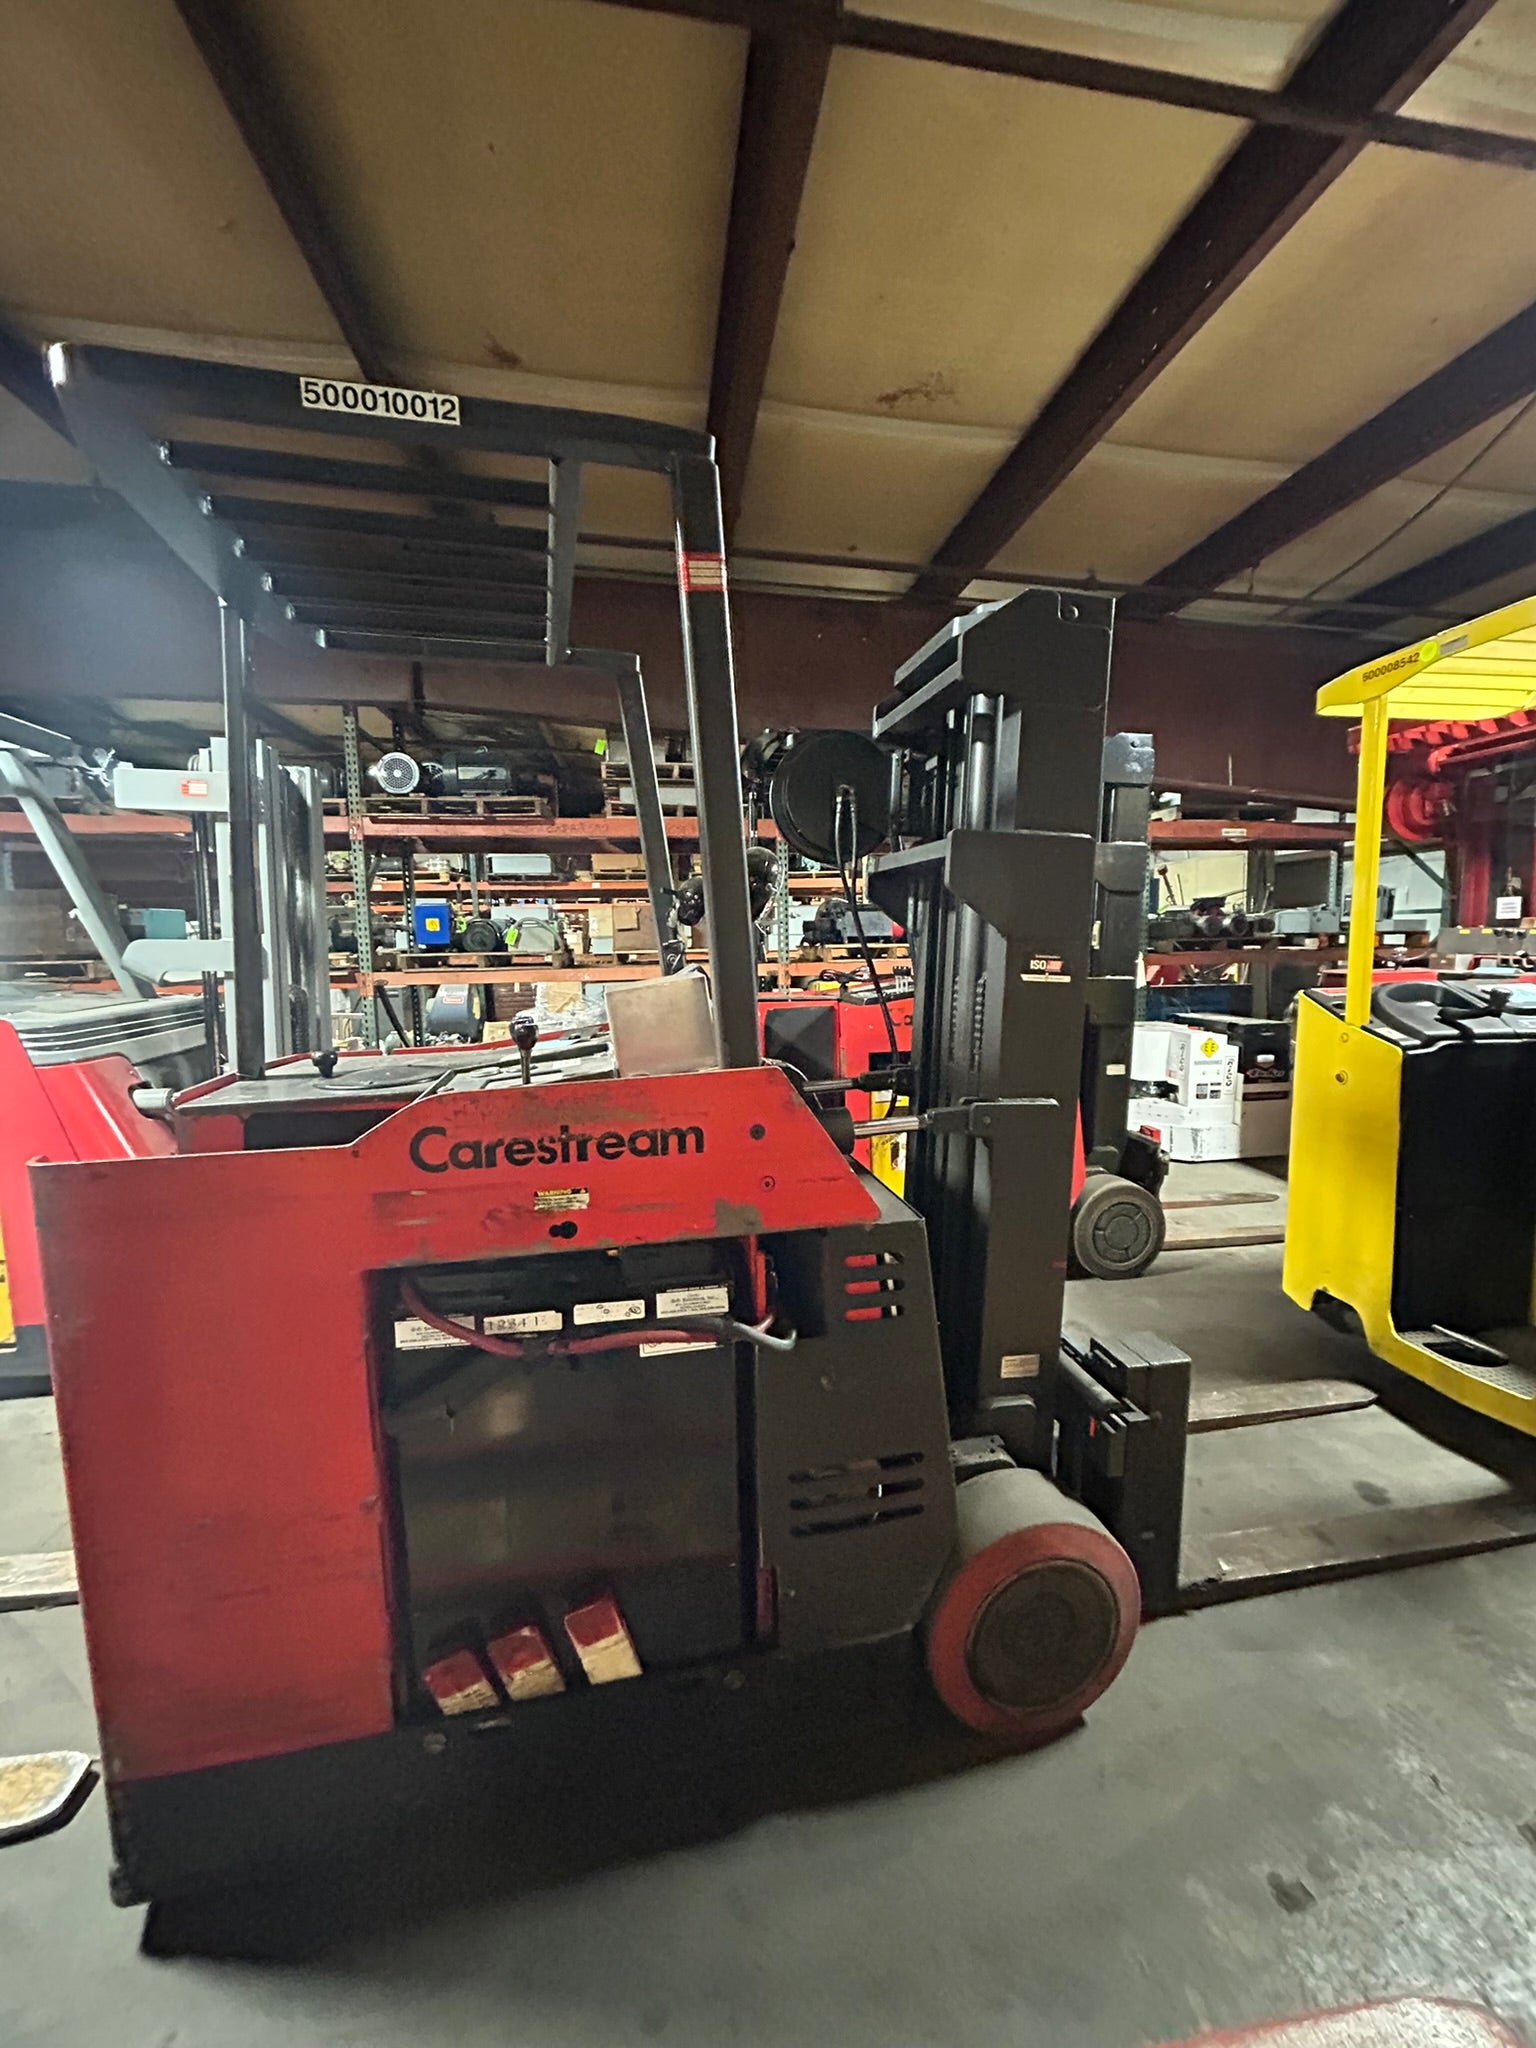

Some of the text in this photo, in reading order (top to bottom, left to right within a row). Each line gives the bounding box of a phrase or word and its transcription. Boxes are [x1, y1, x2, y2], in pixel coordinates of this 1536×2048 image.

[303, 380, 458, 422] 500010012
[1362, 652, 1421, 682] 500008542
[409, 1124, 705, 1173] Carestream
